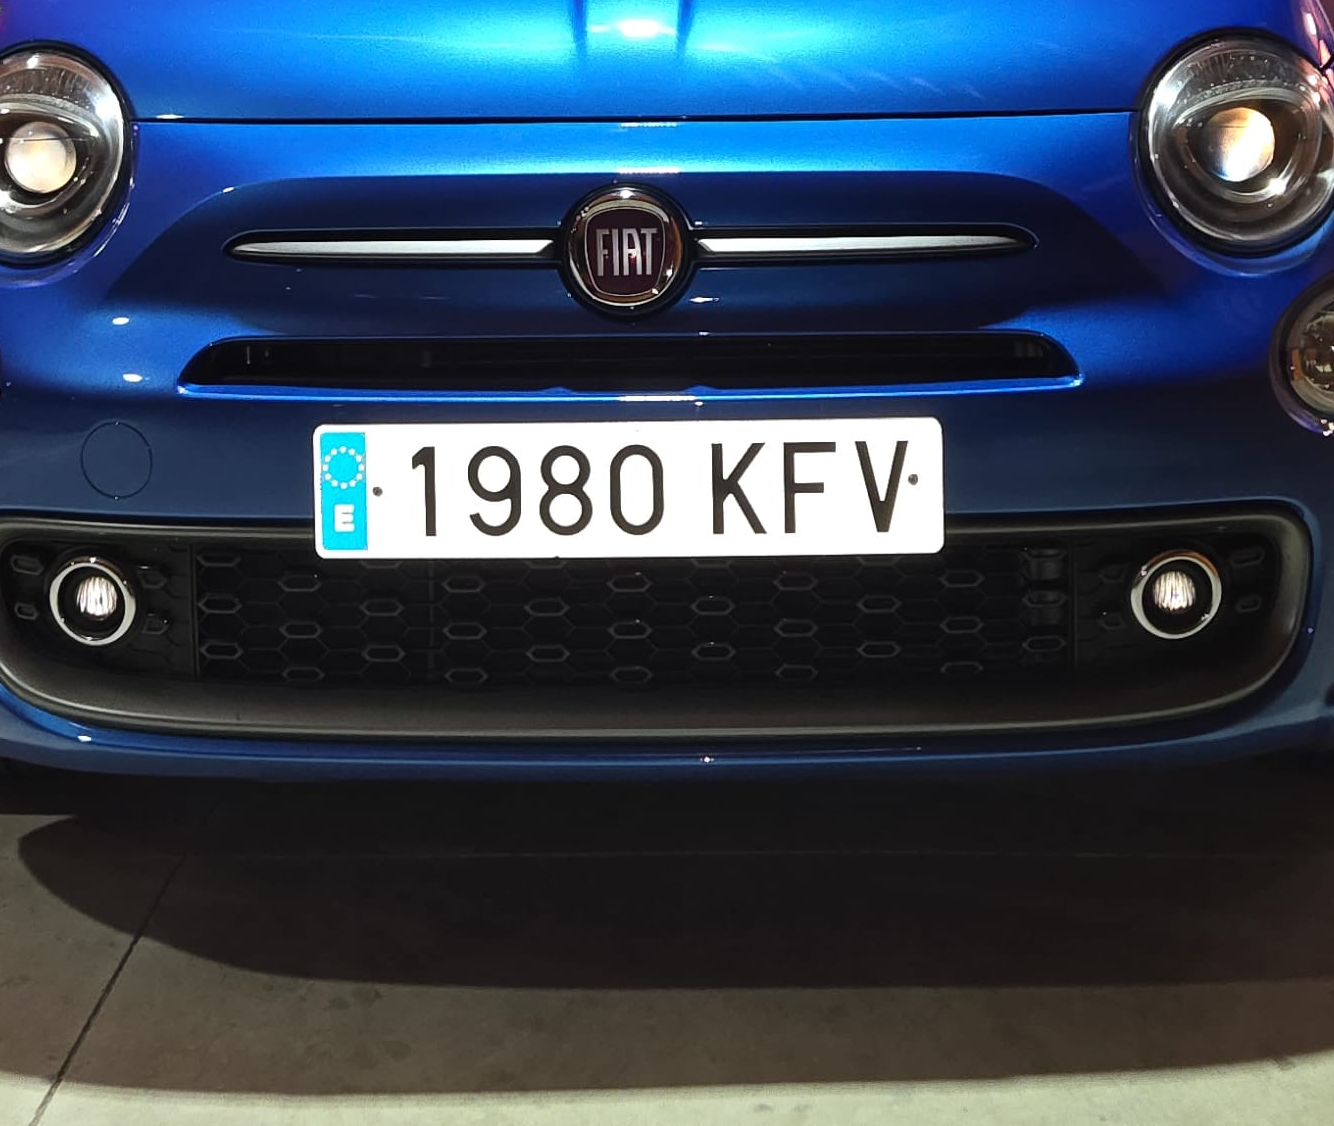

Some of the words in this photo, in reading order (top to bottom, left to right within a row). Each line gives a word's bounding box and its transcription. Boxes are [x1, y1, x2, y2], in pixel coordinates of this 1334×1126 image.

[595, 227, 657, 276] FIAT
[334, 503, 355, 533] E
[410, 443, 665, 538] 1980
[711, 440, 909, 535] KFV
